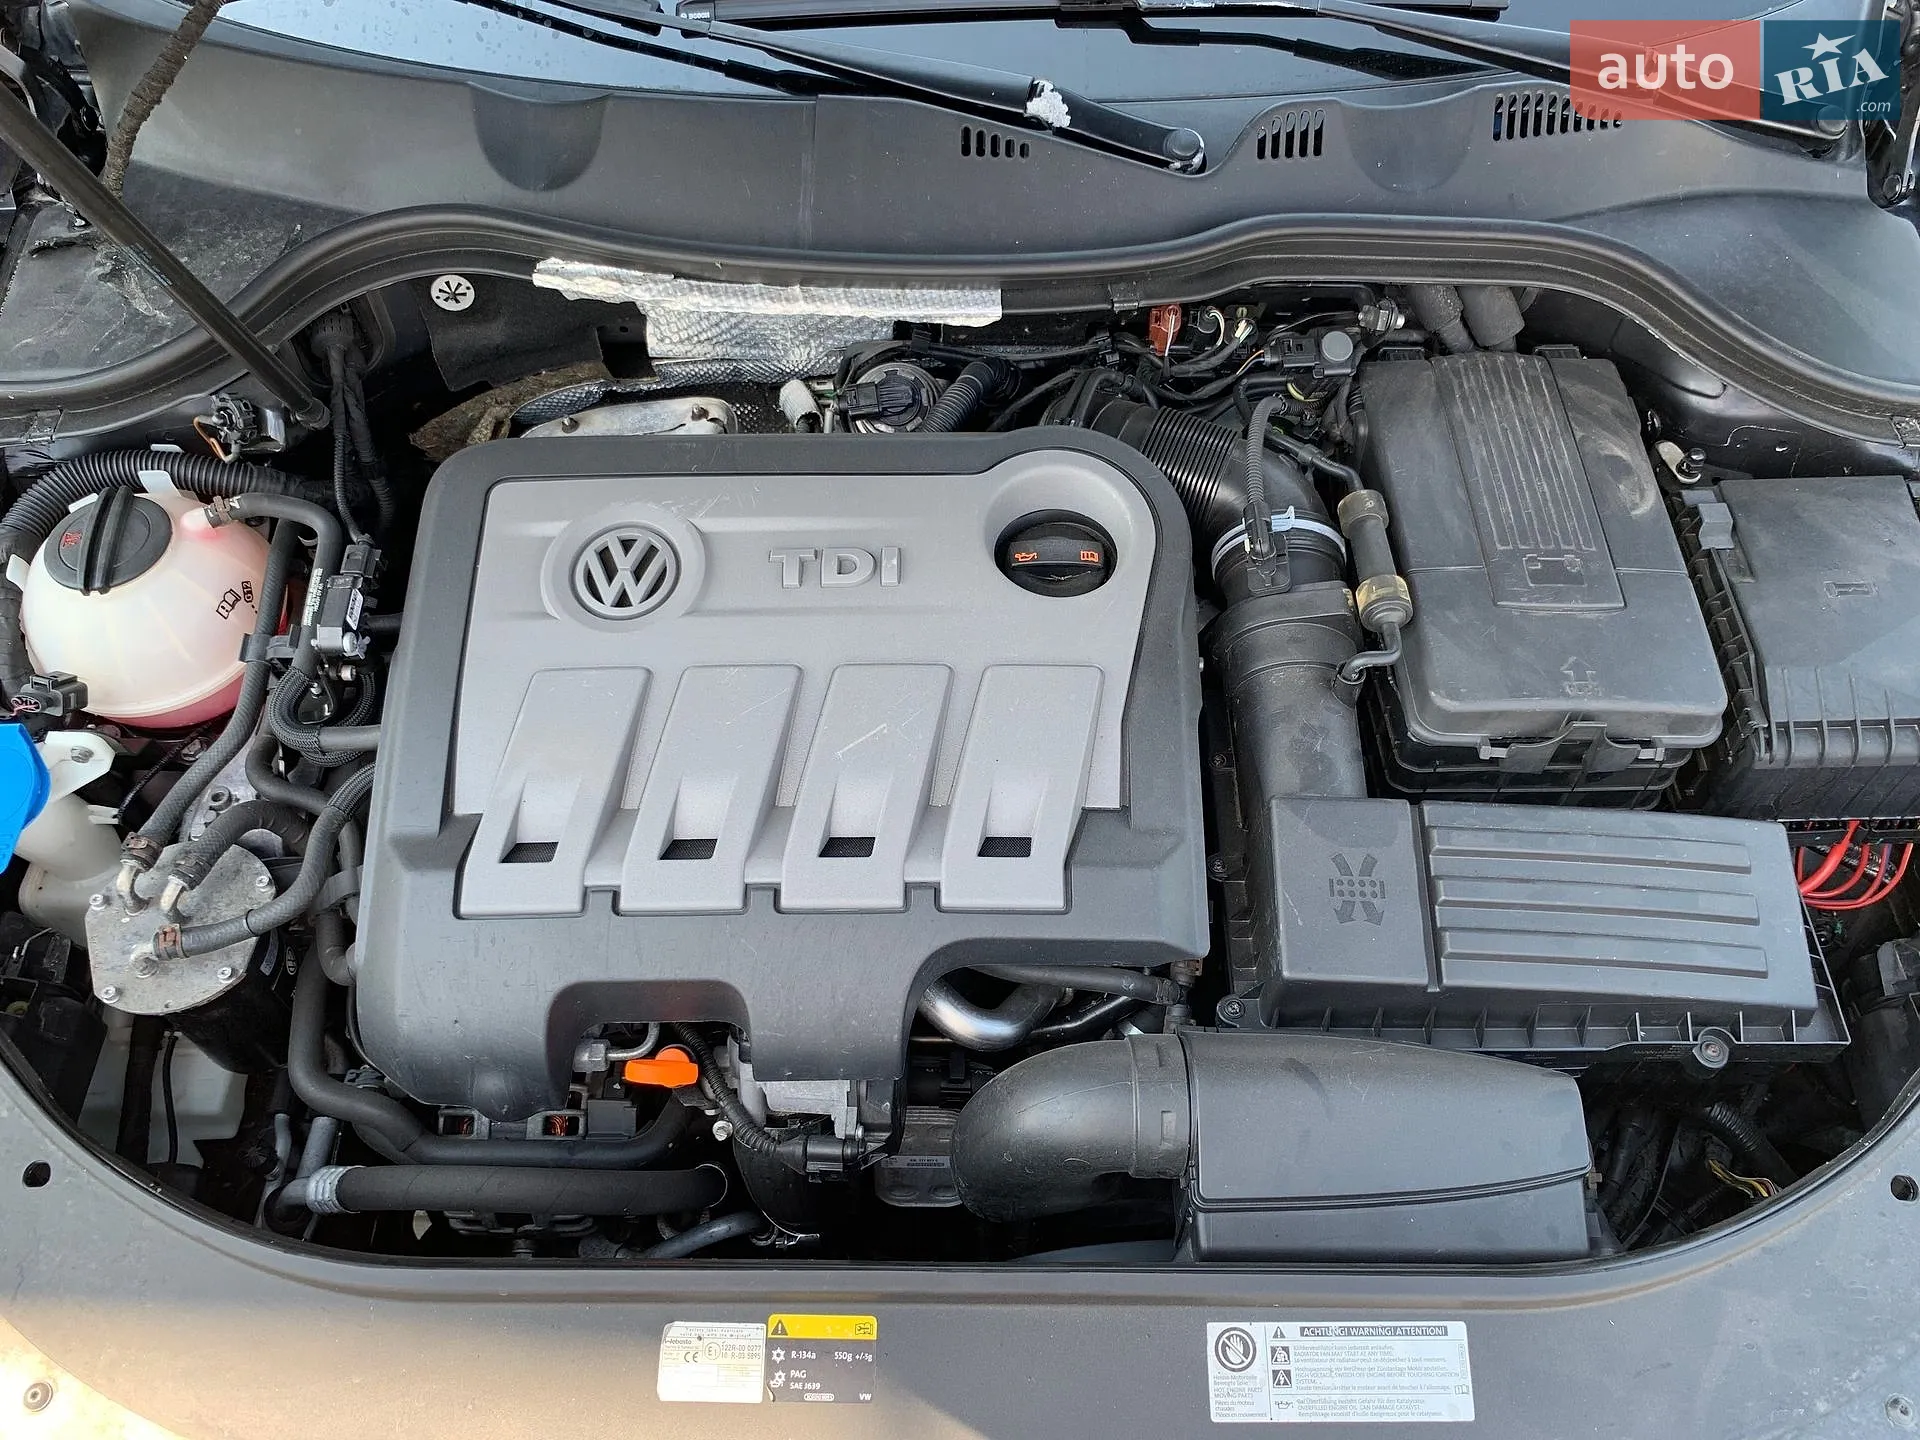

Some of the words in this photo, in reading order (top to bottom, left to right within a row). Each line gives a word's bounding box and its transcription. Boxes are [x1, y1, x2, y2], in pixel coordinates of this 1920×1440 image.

[768, 546, 902, 589] TDI
[1303, 1326, 1348, 1337] ACHTUNG!
[1350, 1326, 1395, 1337] WARNING!
[1396, 1325, 1445, 1336] ATTENTION!
[791, 1350, 817, 1360] R-134a
[834, 1351, 853, 1362] 550g
[790, 1370, 807, 1379] PAG
[790, 1382, 803, 1390] SAE
[804, 1382, 821, 1390] J639
[859, 1393, 872, 1401] VW
